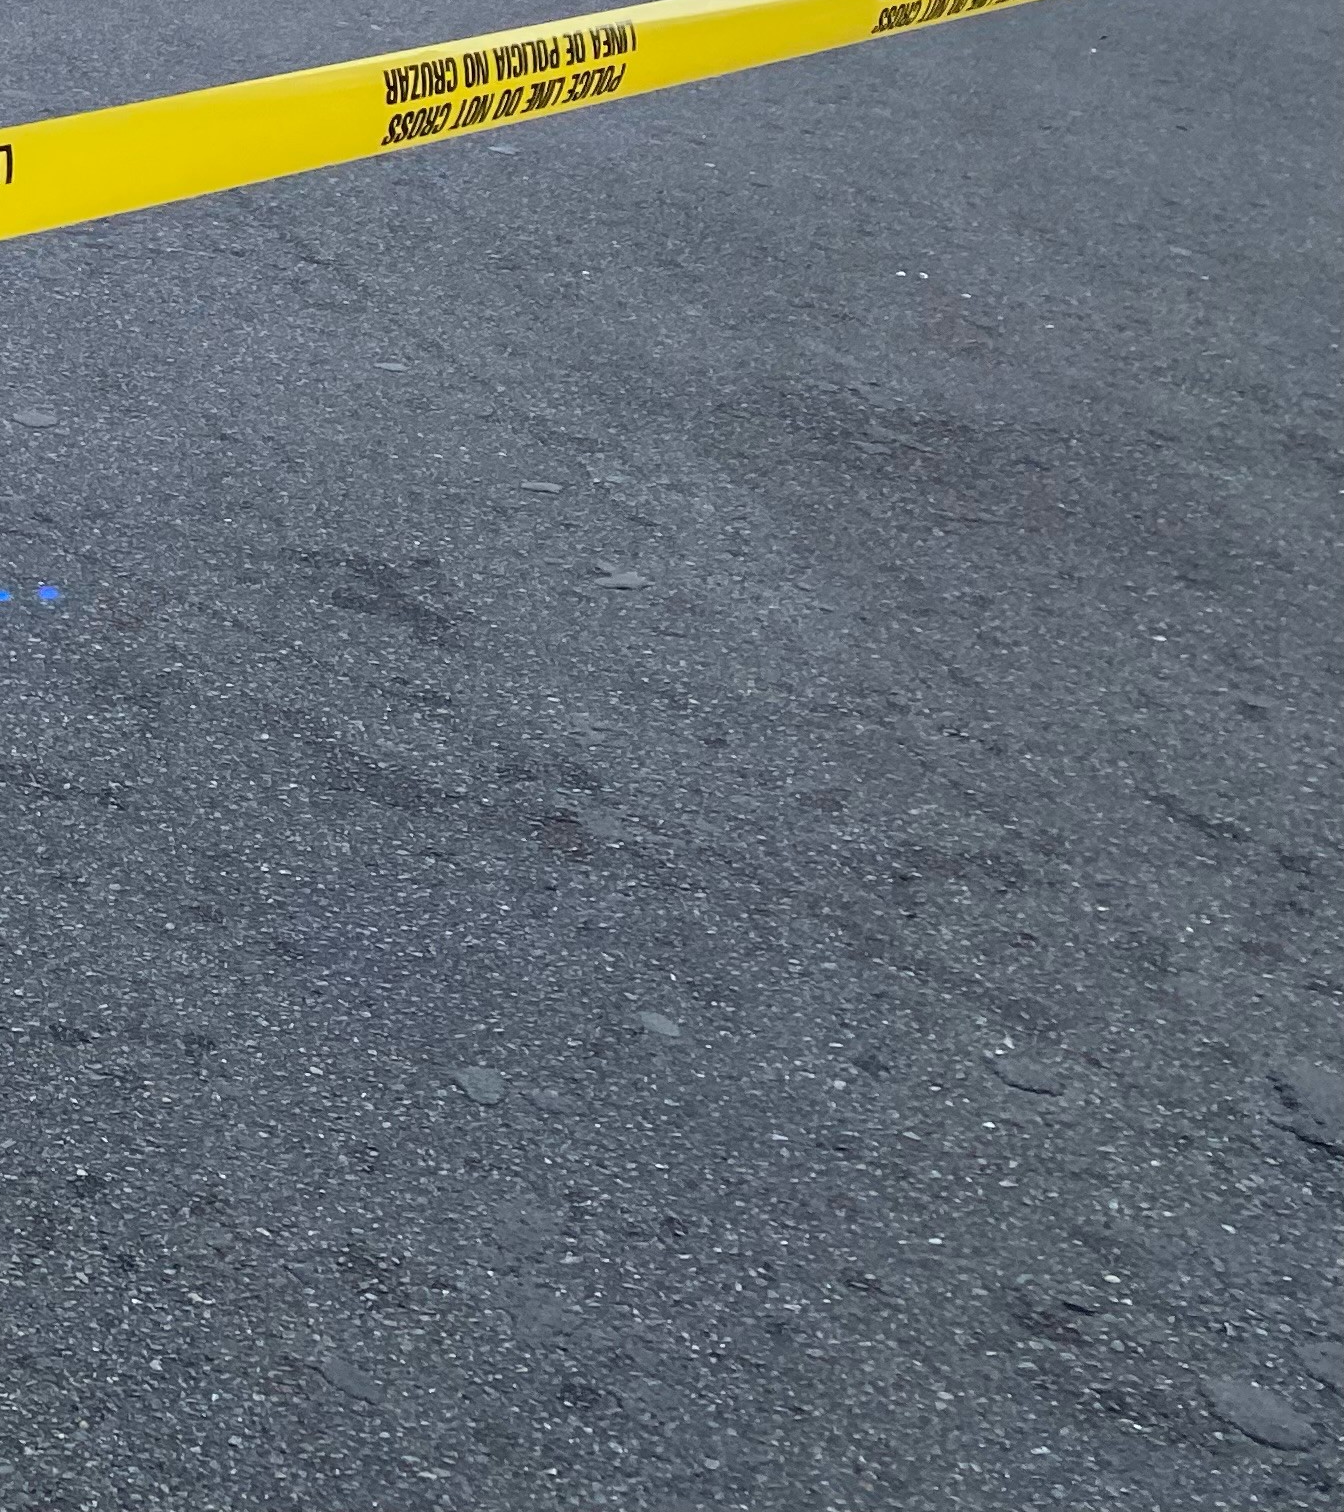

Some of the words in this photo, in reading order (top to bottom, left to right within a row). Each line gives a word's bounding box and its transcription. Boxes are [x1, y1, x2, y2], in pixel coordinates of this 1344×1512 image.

[566, 35, 585, 66] DE
[589, 20, 637, 60] LINEA
[464, 51, 489, 88] NO
[495, 40, 560, 81] POLICIA
[384, 58, 456, 105] CRUZAR
[521, 77, 563, 113] LINE
[562, 63, 626, 104] POLICE
[449, 94, 494, 129] NOT
[492, 86, 524, 120] DO
[382, 103, 451, 146] CROSS
